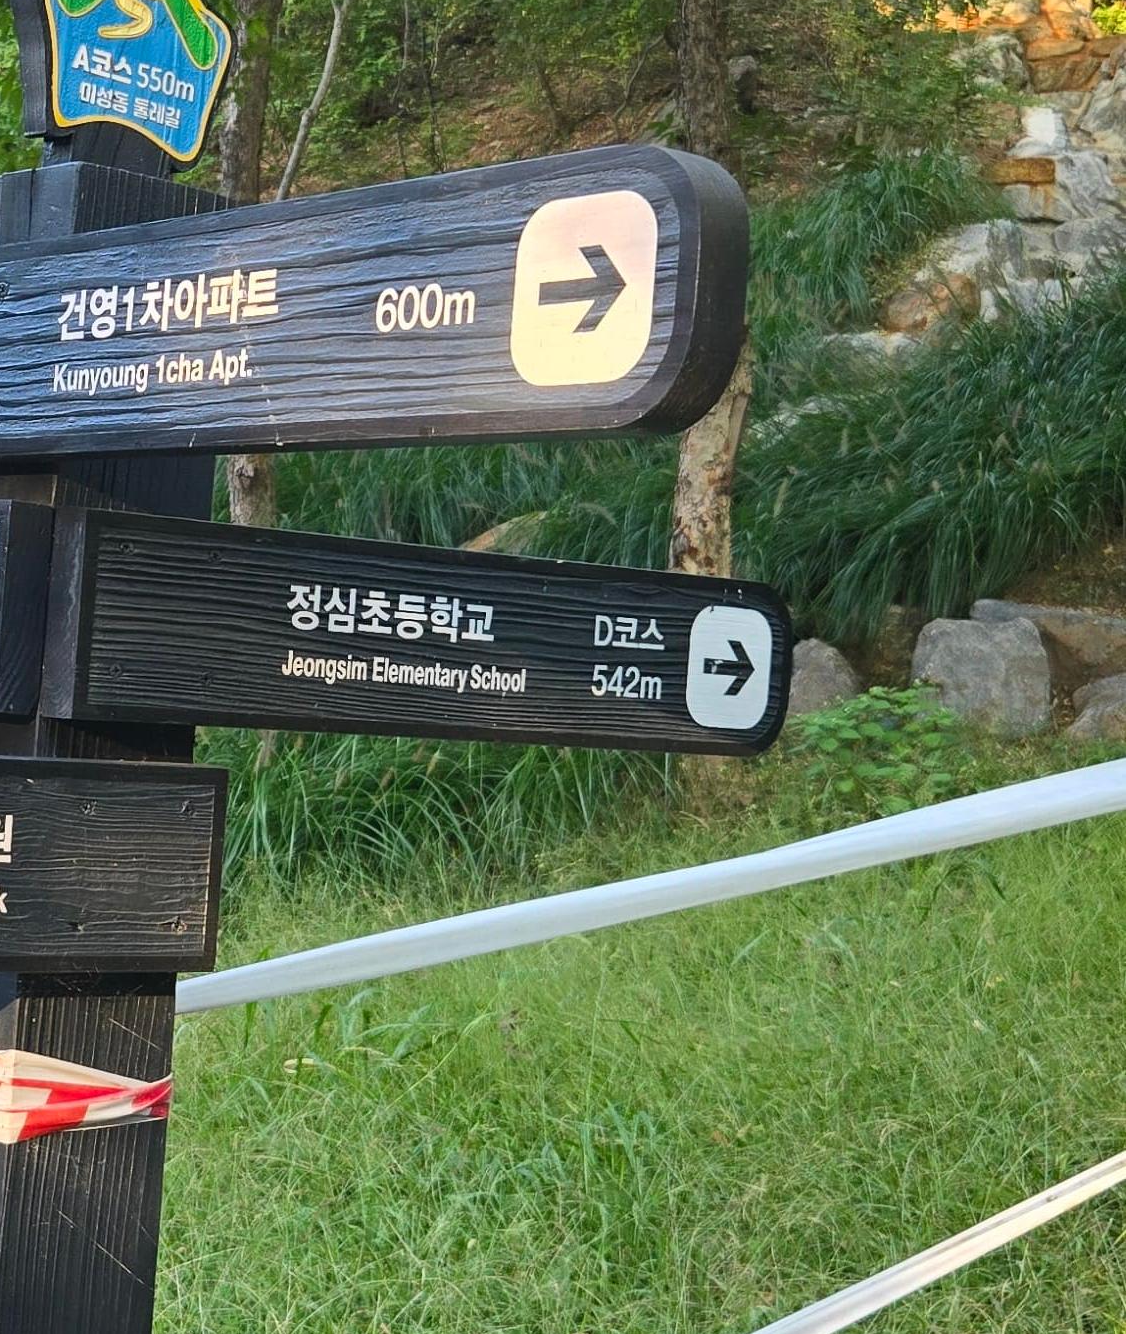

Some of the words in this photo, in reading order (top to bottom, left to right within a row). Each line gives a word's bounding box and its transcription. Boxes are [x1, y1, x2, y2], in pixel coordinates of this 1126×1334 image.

[72, 44, 132, 85] A코스
[136, 63, 195, 103] 550m
[79, 82, 129, 114] 미성동
[133, 97, 181, 129] 둘레길
[58, 269, 279, 341] 건영1차아파트
[375, 283, 476, 334] 600m
[53, 363, 149, 396] Kunyoung
[155, 353, 204, 384] 1cha
[209, 348, 253, 385] Apt.
[287, 584, 495, 644] 정심초등학교
[594, 614, 665, 651] D코스
[281, 650, 368, 685] Jeongsim
[372, 657, 468, 693] Elementary
[470, 664, 526, 693] School
[591, 665, 663, 701] 542m
